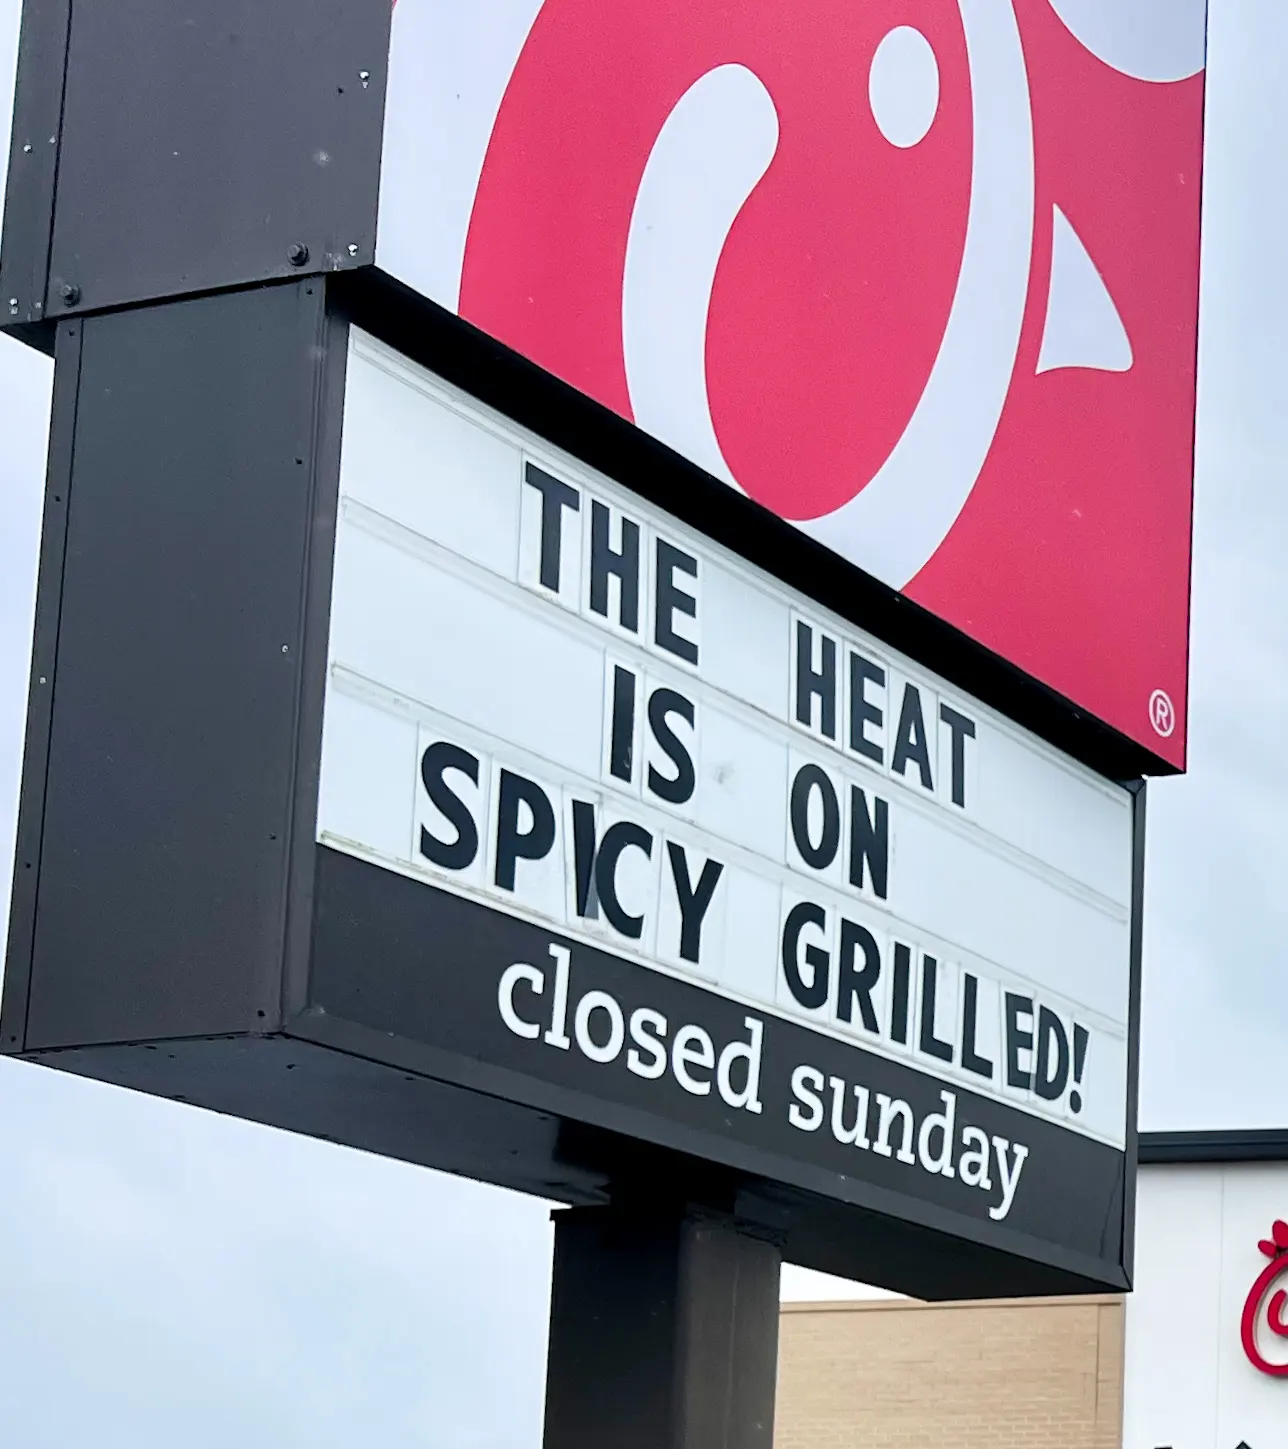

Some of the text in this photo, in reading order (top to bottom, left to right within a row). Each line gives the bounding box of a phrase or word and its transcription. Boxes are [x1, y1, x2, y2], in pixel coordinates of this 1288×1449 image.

[524, 461, 976, 808] THE HEAT
[610, 664, 888, 900] IS ON
[420, 741, 1089, 1115] SPICY GRILLED!
[498, 943, 1029, 1220] closed sunday
